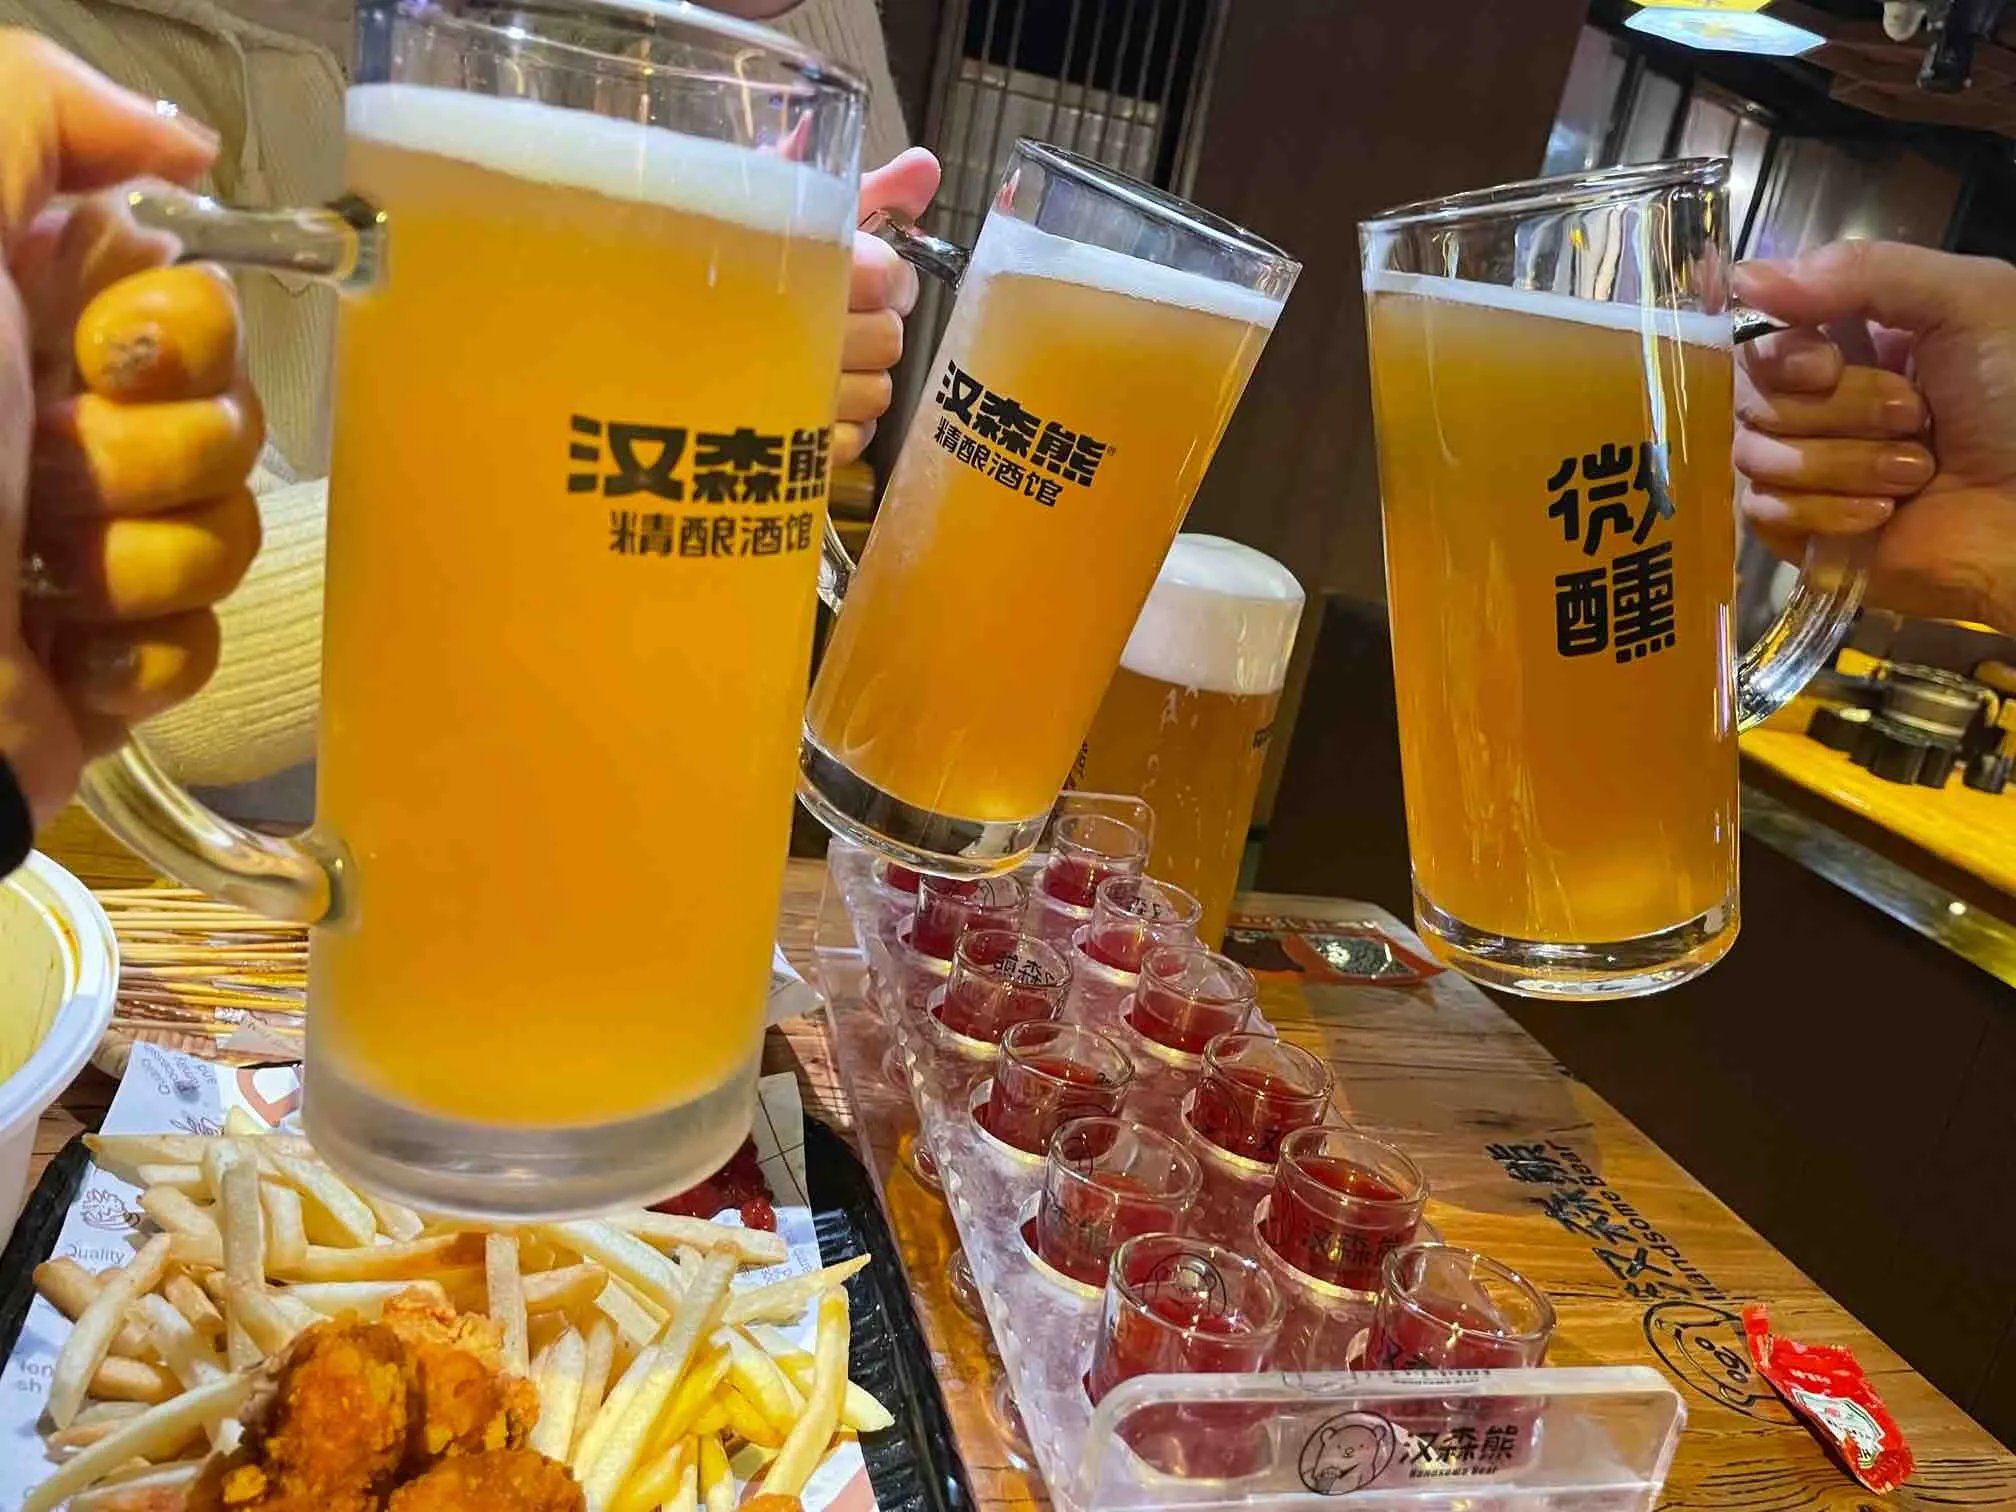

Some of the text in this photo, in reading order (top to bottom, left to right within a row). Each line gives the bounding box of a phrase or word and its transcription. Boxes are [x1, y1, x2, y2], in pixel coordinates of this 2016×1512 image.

[567, 413, 832, 504] 汉森熊
[934, 415, 1063, 507] 精酿酒馆
[935, 360, 1107, 488] 汉森熊
[608, 510, 813, 558] 精酿酒馆
[1485, 1142, 1691, 1300] 汉森熊
[1399, 1424, 1519, 1464] 汉森熊
